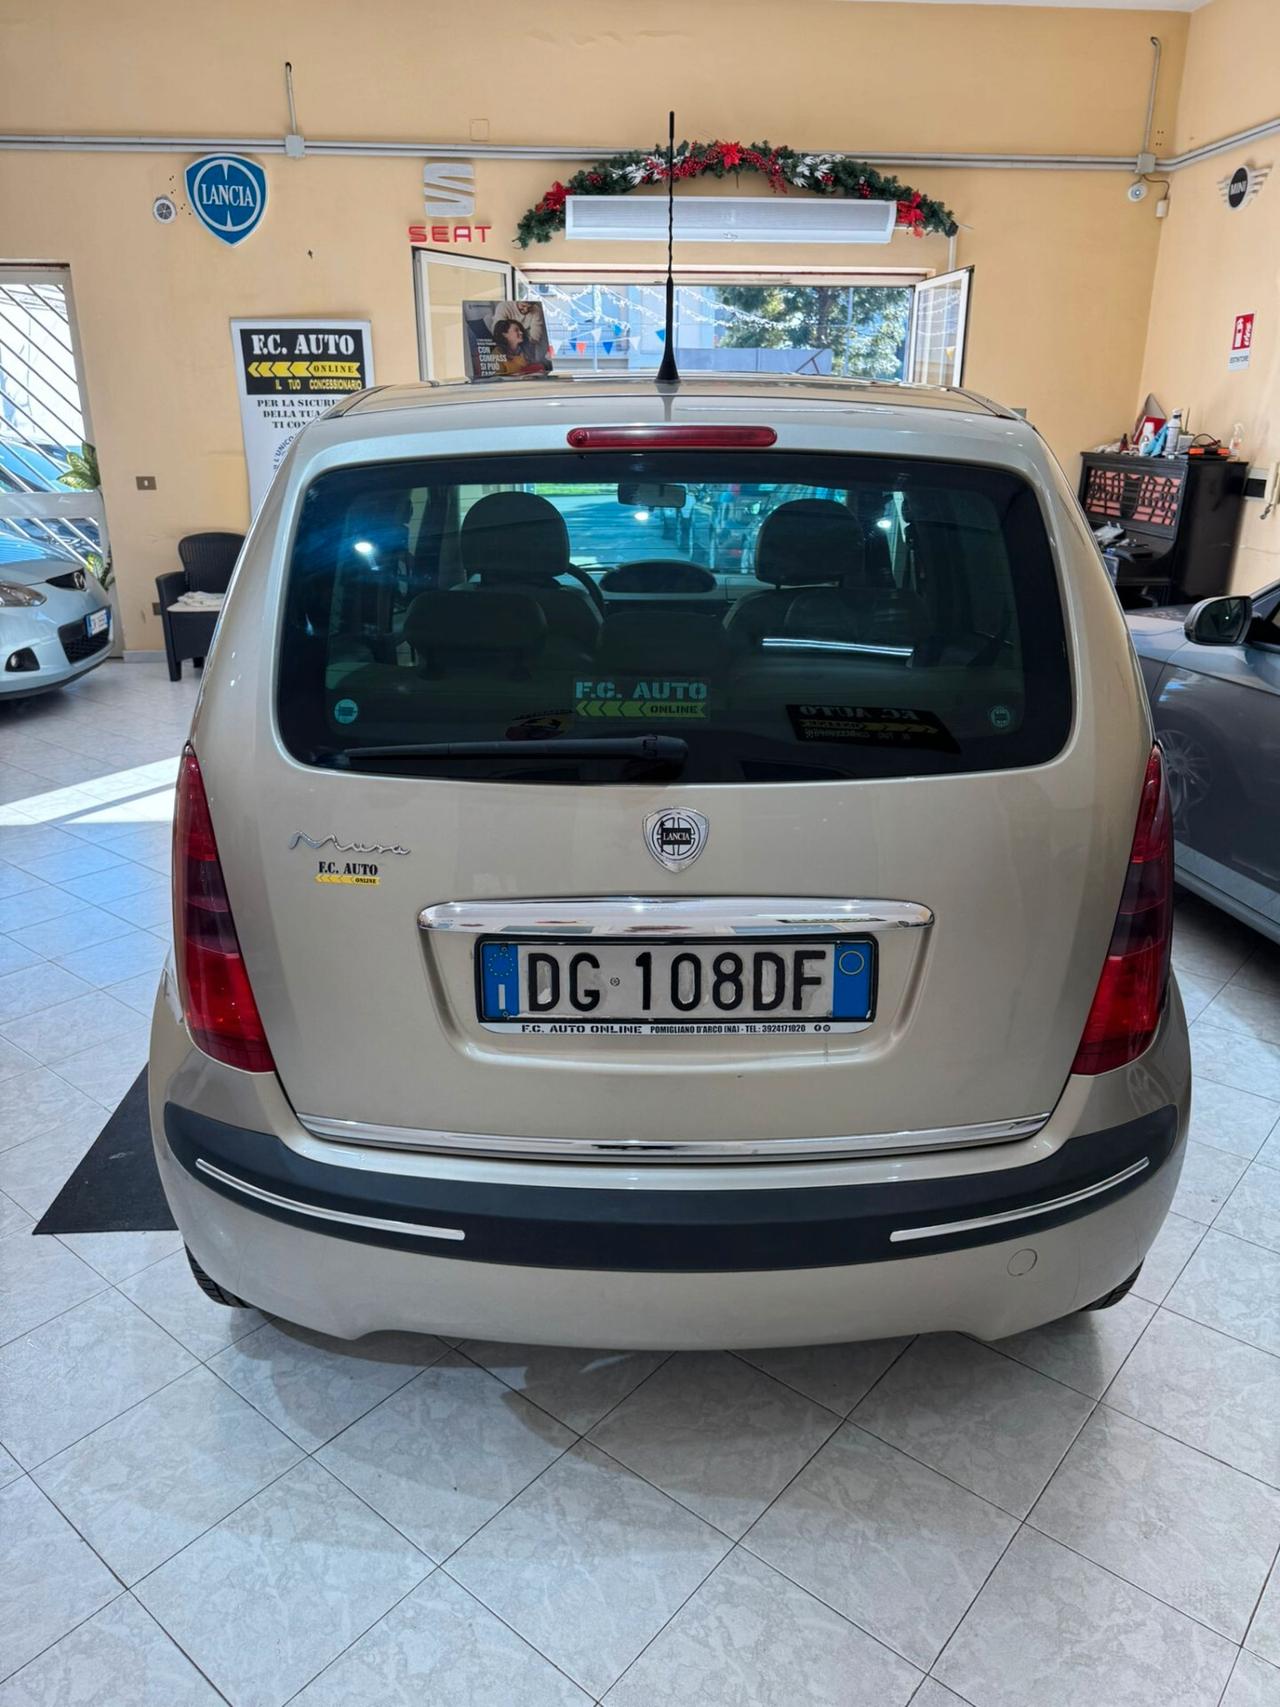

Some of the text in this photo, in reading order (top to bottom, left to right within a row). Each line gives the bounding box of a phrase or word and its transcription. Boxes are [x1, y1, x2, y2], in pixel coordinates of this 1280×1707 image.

[201, 183, 255, 207] LANCIA
[408, 225, 492, 243] SEAT
[251, 334, 355, 355] F.C. AUTO
[480, 354, 507, 362] COMPASS
[313, 364, 354, 373] ONLINE
[275, 379, 362, 391] IL TUO CONCESSIONARIO
[257, 399, 279, 408] PER
[282, 399, 295, 408] LA
[263, 410, 296, 418] DELLA
[272, 421, 284, 429] TI
[632, 682, 707, 700] AUTO
[650, 704, 699, 714] ONLINE
[663, 832, 690, 841] LANCIA
[288, 831, 411, 855] Musa
[318, 861, 378, 876] F.C. AUTO
[354, 877, 377, 885] ONLINE
[528, 950, 827, 1012] DG 108DF
[521, 1025, 545, 1034] F.C.
[550, 1025, 586, 1034] AUTO
[590, 1025, 643, 1034] ONLINE
[650, 1025, 695, 1034] POMIGLIANO
[696, 1025, 723, 1034] D'ARCO
